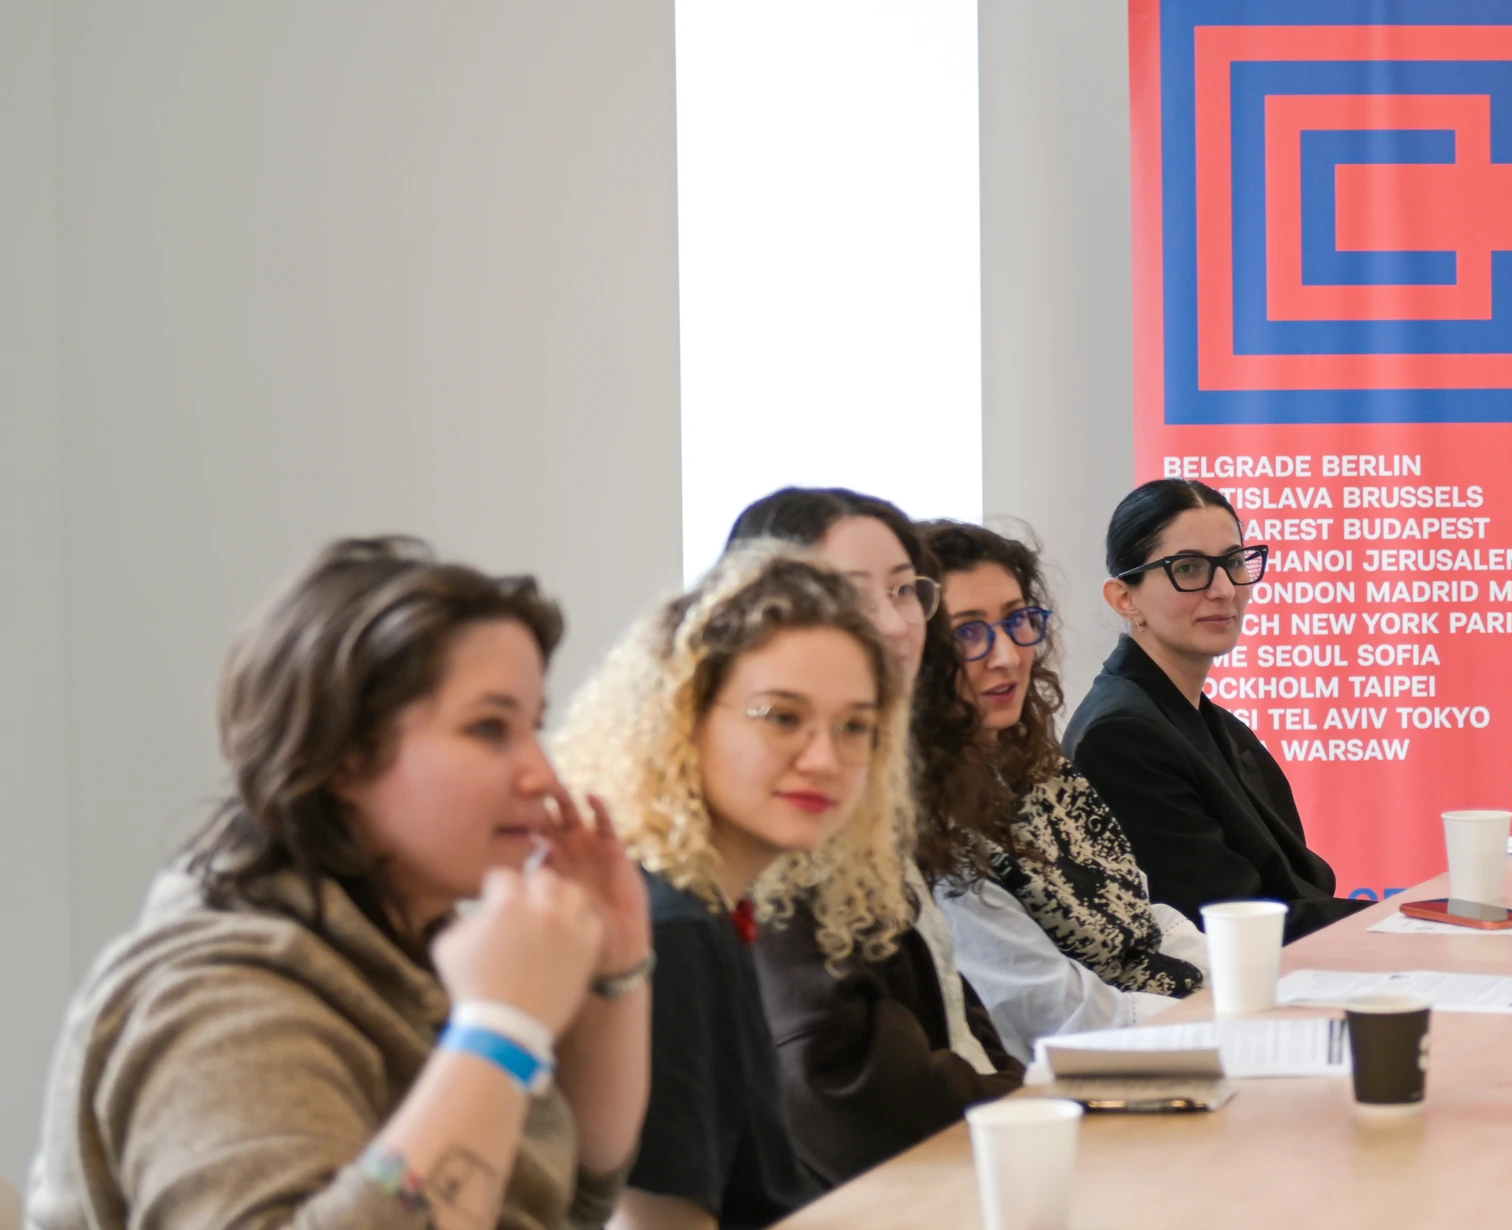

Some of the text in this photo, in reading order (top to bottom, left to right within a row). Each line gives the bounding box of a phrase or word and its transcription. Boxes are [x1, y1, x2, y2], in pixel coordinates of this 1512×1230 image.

[1163, 454, 1421, 479] BELGRADE BERLIN
[1210, 485, 1484, 510] TISLAVA BRUSSELS
[1241, 517, 1491, 541] AREST BUDAPEST
[1264, 549, 1353, 573] HANOI
[1247, 581, 1356, 606] ONDON
[1366, 580, 1479, 603] MADRID
[1291, 613, 1357, 636] NEW
[1361, 612, 1440, 635] YORK
[1257, 644, 1349, 668] SEOUL
[1357, 643, 1441, 667] SOFIA
[1201, 675, 1436, 700] OCKHOLM TAIPEI
[1267, 707, 1318, 731] TEL
[1323, 707, 1388, 730] AVIV
[1395, 705, 1491, 729] TOKYO
[1280, 738, 1411, 762] WARSAW
